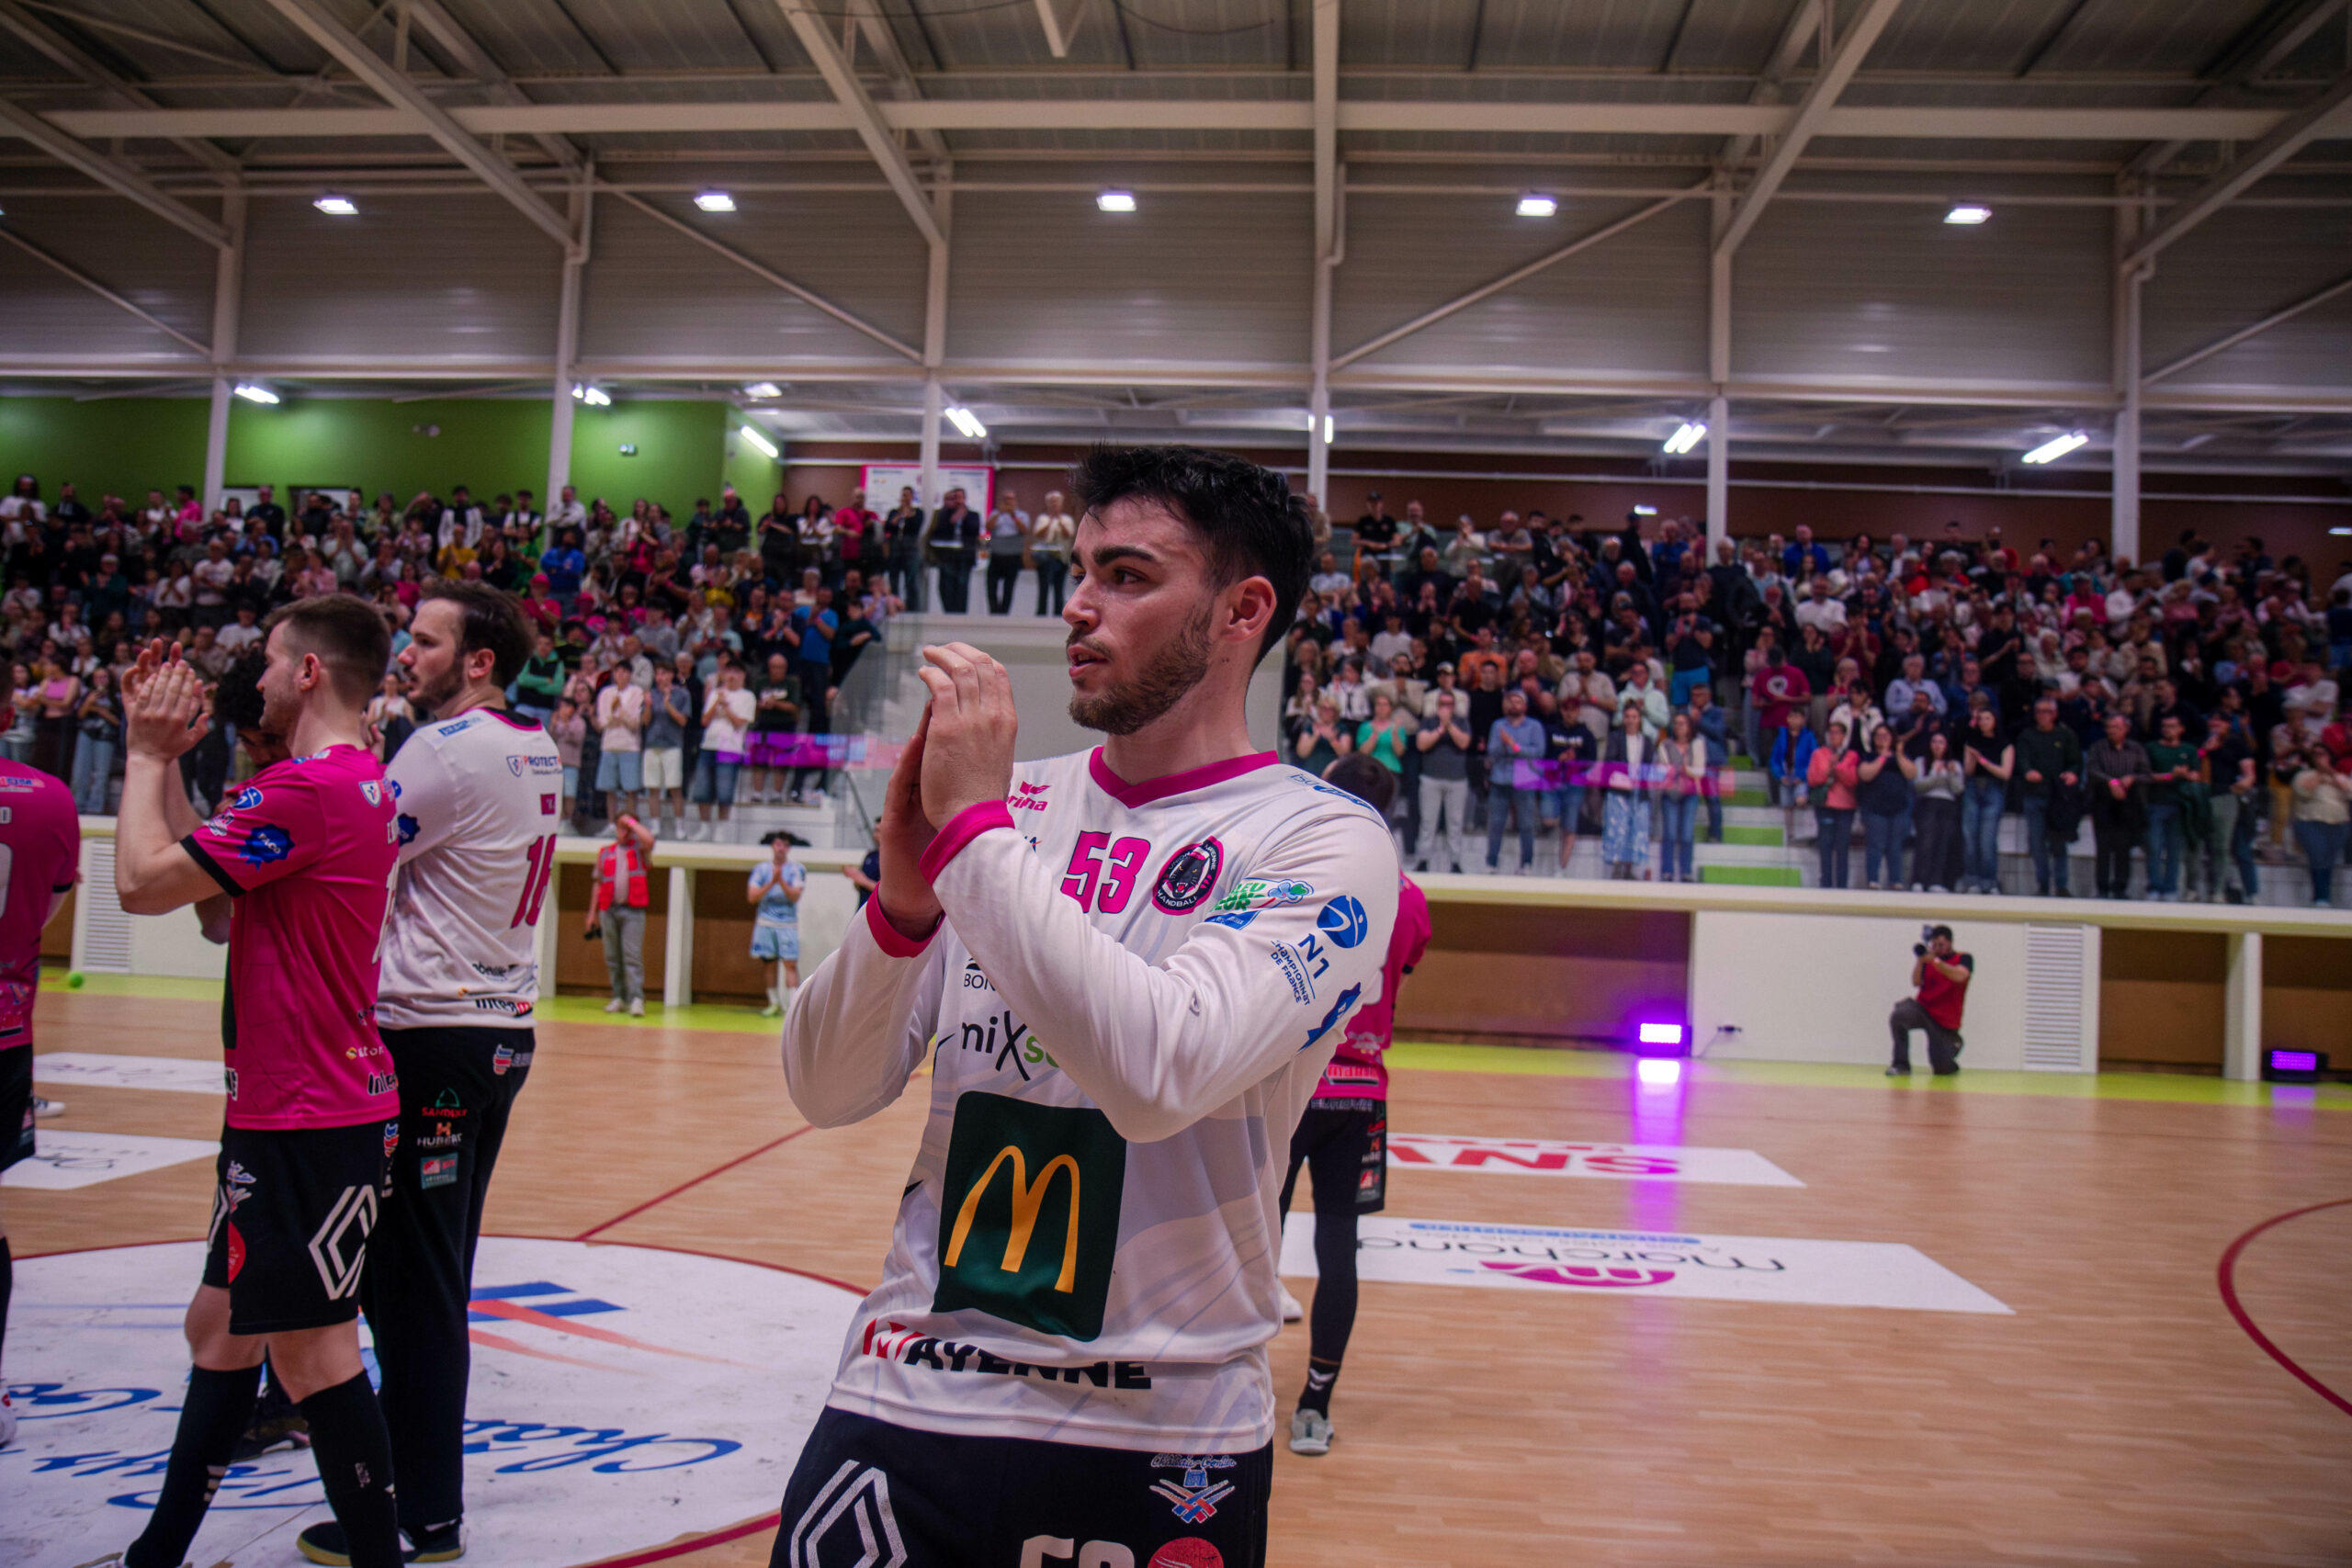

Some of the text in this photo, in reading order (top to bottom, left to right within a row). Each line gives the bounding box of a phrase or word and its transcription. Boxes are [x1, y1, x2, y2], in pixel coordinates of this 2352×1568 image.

[523, 754, 560, 767] PROTECT
[1059, 830, 1151, 914] 53
[1270, 952, 1283, 965] DE
[1297, 932, 1329, 980] N1
[862, 1317, 1151, 1390] MAYENNE
